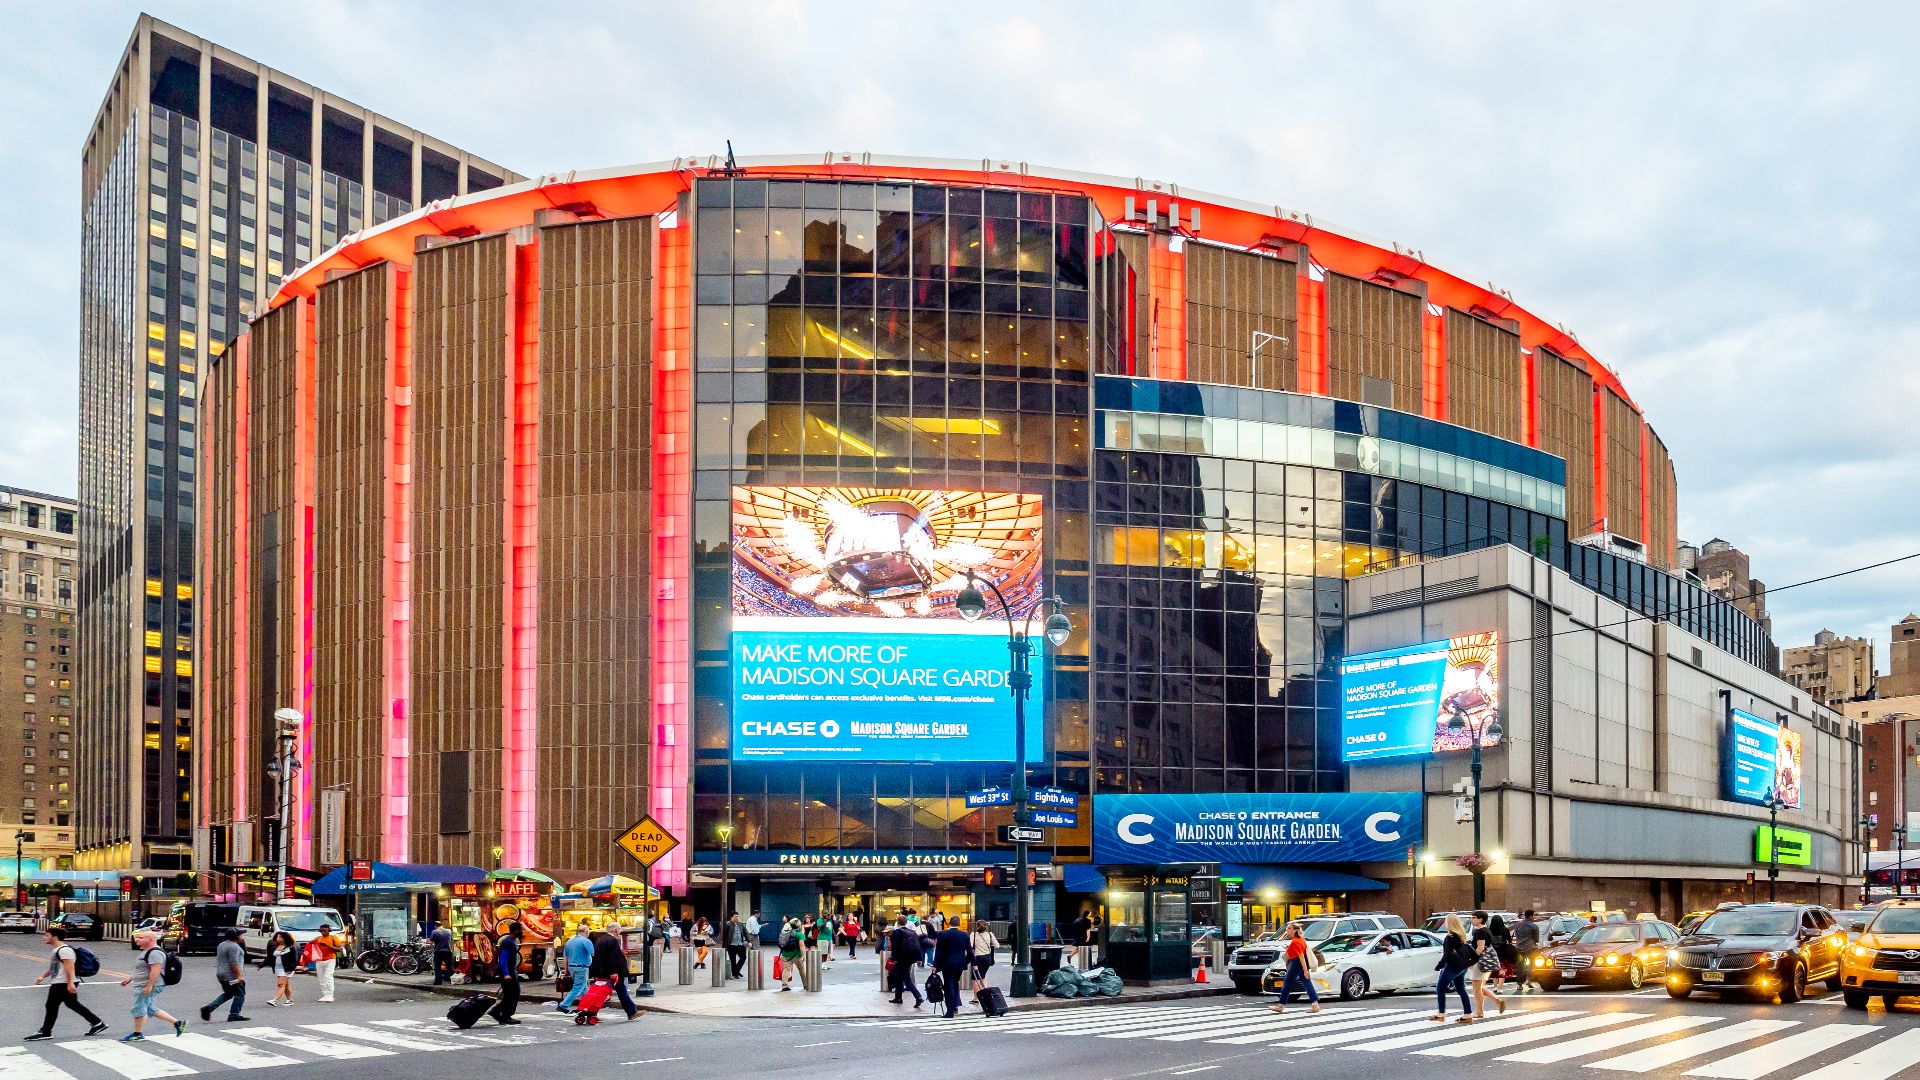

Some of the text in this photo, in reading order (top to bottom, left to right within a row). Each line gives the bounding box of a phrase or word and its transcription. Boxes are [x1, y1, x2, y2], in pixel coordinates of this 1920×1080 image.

[742, 645, 908, 664] MAKE MORE OF
[742, 667, 1011, 689] MADISON SQUARE GARDE
[1346, 680, 1398, 695] MAKE MORE OF
[1346, 683, 1438, 703] MADISON SQUARE GARDEN
[742, 694, 764, 702] Chase
[766, 694, 809, 702] cardholders
[850, 694, 884, 702] exclusive
[918, 695, 933, 703] Visit
[742, 721, 816, 736] CHASE
[851, 720, 892, 736] MADISON
[894, 720, 929, 736] SQUARE
[1346, 734, 1376, 745] CHASE
[970, 794, 986, 804] West
[1001, 793, 1009, 802] St
[1034, 792, 1074, 804] Eighth Ave
[1035, 814, 1046, 822] Joe
[1046, 814, 1064, 824] Louis
[1199, 812, 1319, 820] CHASE ENTRANCE
[1117, 814, 1154, 845] C
[1176, 822, 1234, 840] MADISON
[1238, 822, 1287, 841] SQUARE
[1364, 812, 1401, 842] C
[632, 832, 662, 842] DEAD
[1013, 830, 1023, 838] ONE
[636, 844, 658, 852] END
[780, 854, 968, 864] PENNSYLVANIA STATION
[454, 884, 476, 894] HOT DOG
[495, 884, 538, 895] ALAFEL
